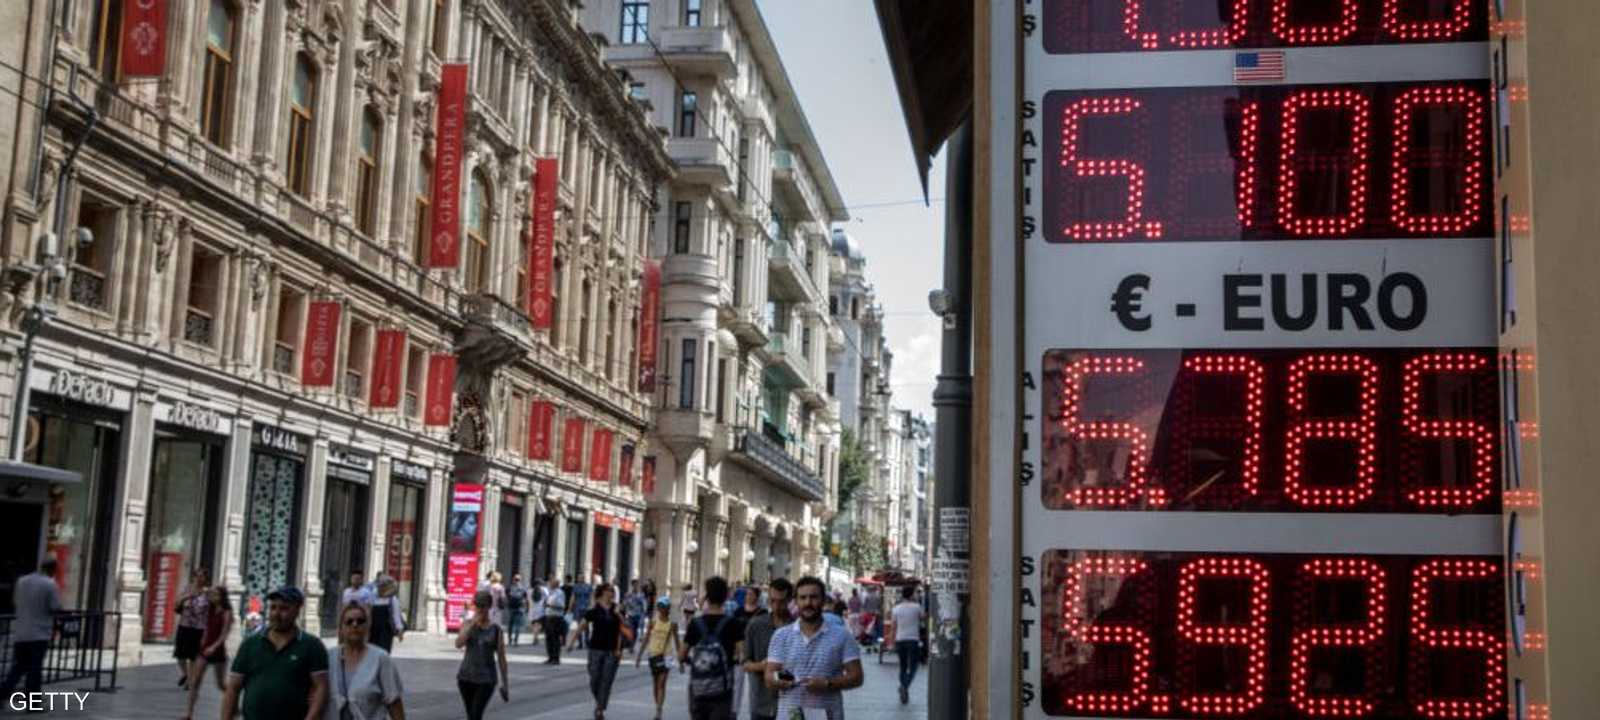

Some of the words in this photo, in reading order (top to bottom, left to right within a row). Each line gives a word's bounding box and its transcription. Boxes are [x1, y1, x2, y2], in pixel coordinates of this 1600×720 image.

[440, 102, 458, 222] GRANDPERA
[1061, 87, 1483, 239] 5.100
[534, 191, 549, 293] GRANDPERA
[1110, 273, 1152, 332] €
[1175, 302, 1197, 317] -
[1222, 271, 1428, 332] EURO
[1062, 354, 1493, 506] 5.785
[1065, 558, 1504, 717] 5.925
